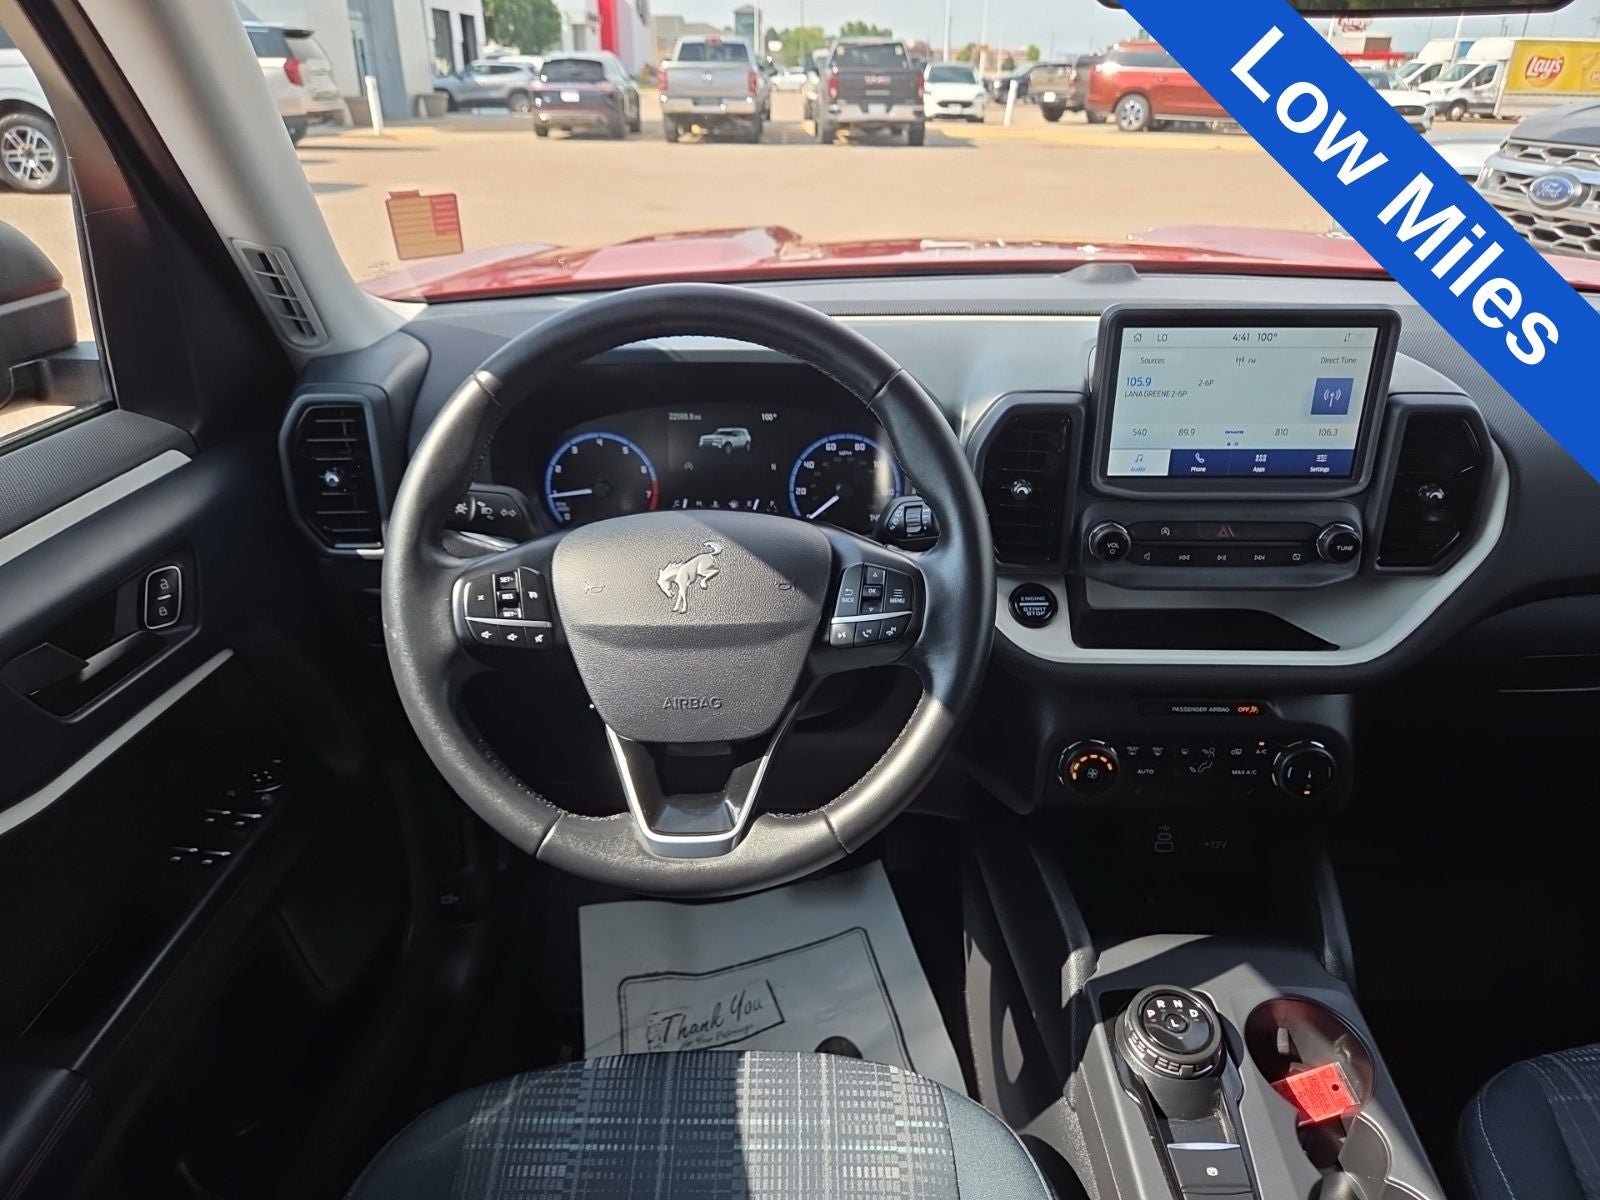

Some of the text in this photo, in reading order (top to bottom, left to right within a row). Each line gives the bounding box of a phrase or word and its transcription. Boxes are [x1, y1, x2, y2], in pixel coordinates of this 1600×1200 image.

[1526, 56, 1563, 80] Lay's
[1157, 333, 1168, 342] LO
[1232, 332, 1278, 342] 4:41 100°
[1140, 357, 1165, 365] Sources
[1126, 377, 1152, 387] 105.9
[1125, 390, 1187, 398] LANA GREENE 2-6P
[1132, 428, 1147, 437] 540
[1178, 428, 1195, 437] 89.9
[1275, 428, 1288, 437] 810
[1318, 428, 1338, 437] 106.3
[596, 438, 603, 447] 4
[825, 443, 837, 451] 60
[854, 443, 866, 451] 80
[622, 446, 629, 455] 5
[555, 465, 562, 473] 2
[640, 465, 647, 474] 6
[803, 461, 815, 469] 40
[645, 490, 652, 499] 7
[795, 487, 807, 496] 20
[662, 696, 722, 710] AIRBAG
[1146, 999, 1199, 1018] P R N D
[661, 988, 764, 1044] Thank You
[1170, 1019, 1180, 1028] L
